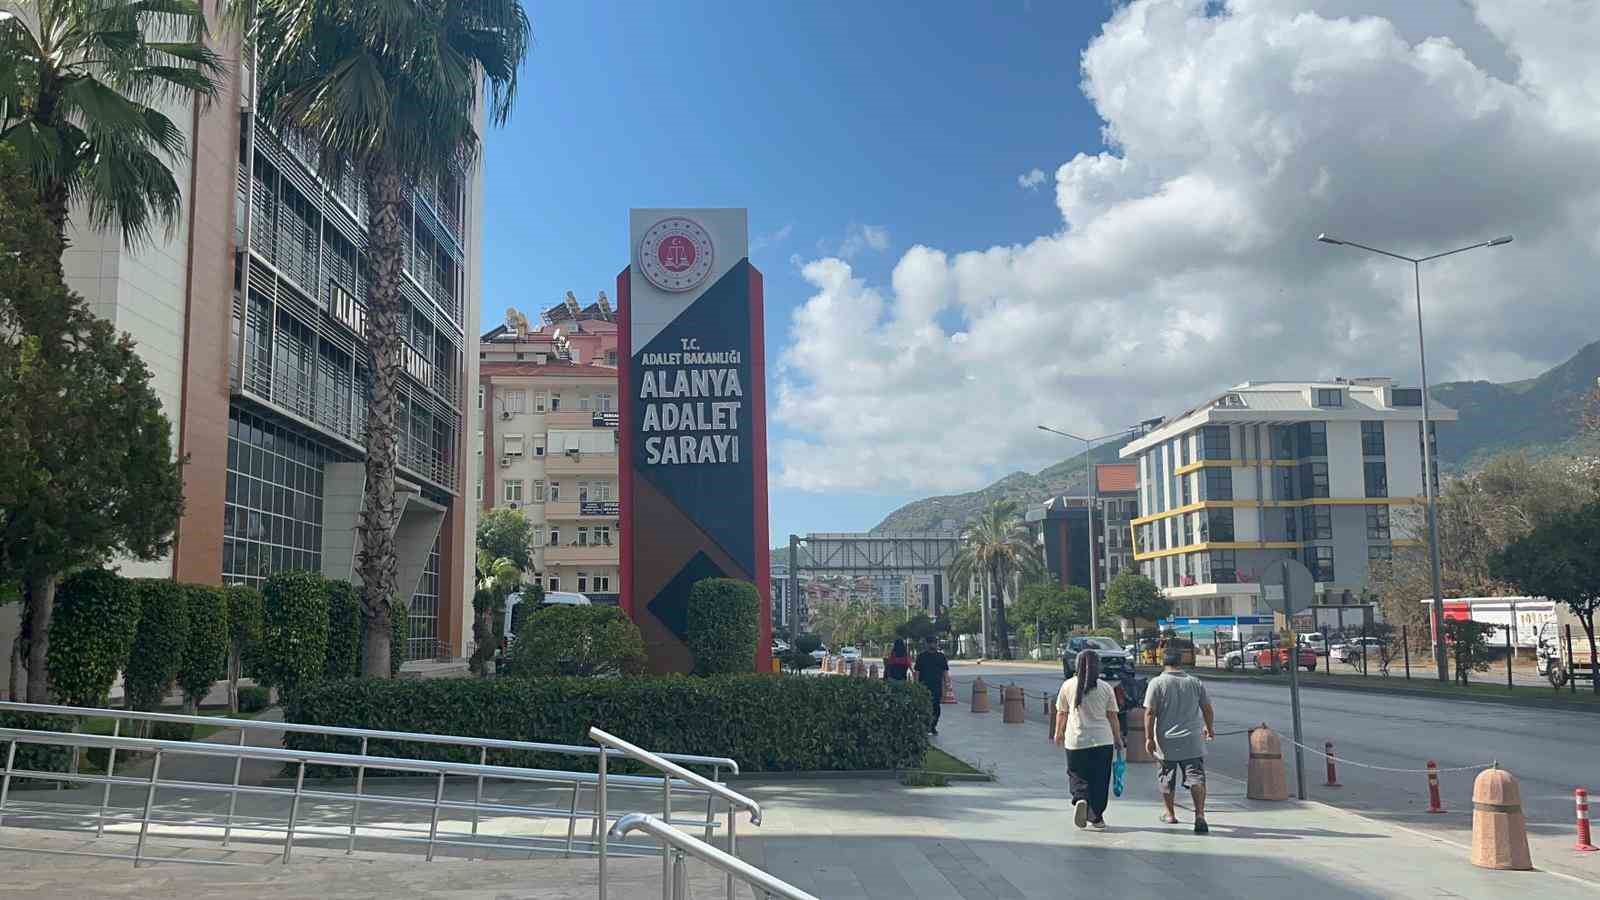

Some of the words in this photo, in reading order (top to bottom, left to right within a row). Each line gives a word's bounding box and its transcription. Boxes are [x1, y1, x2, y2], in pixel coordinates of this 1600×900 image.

[641, 352, 682, 366] ADALET
[683, 349, 741, 365] BAKANLIĞI
[680, 338, 700, 350] T.C.
[640, 368, 743, 398] ALANYA
[642, 401, 741, 431] ADALET
[645, 434, 739, 464] SARAYI
